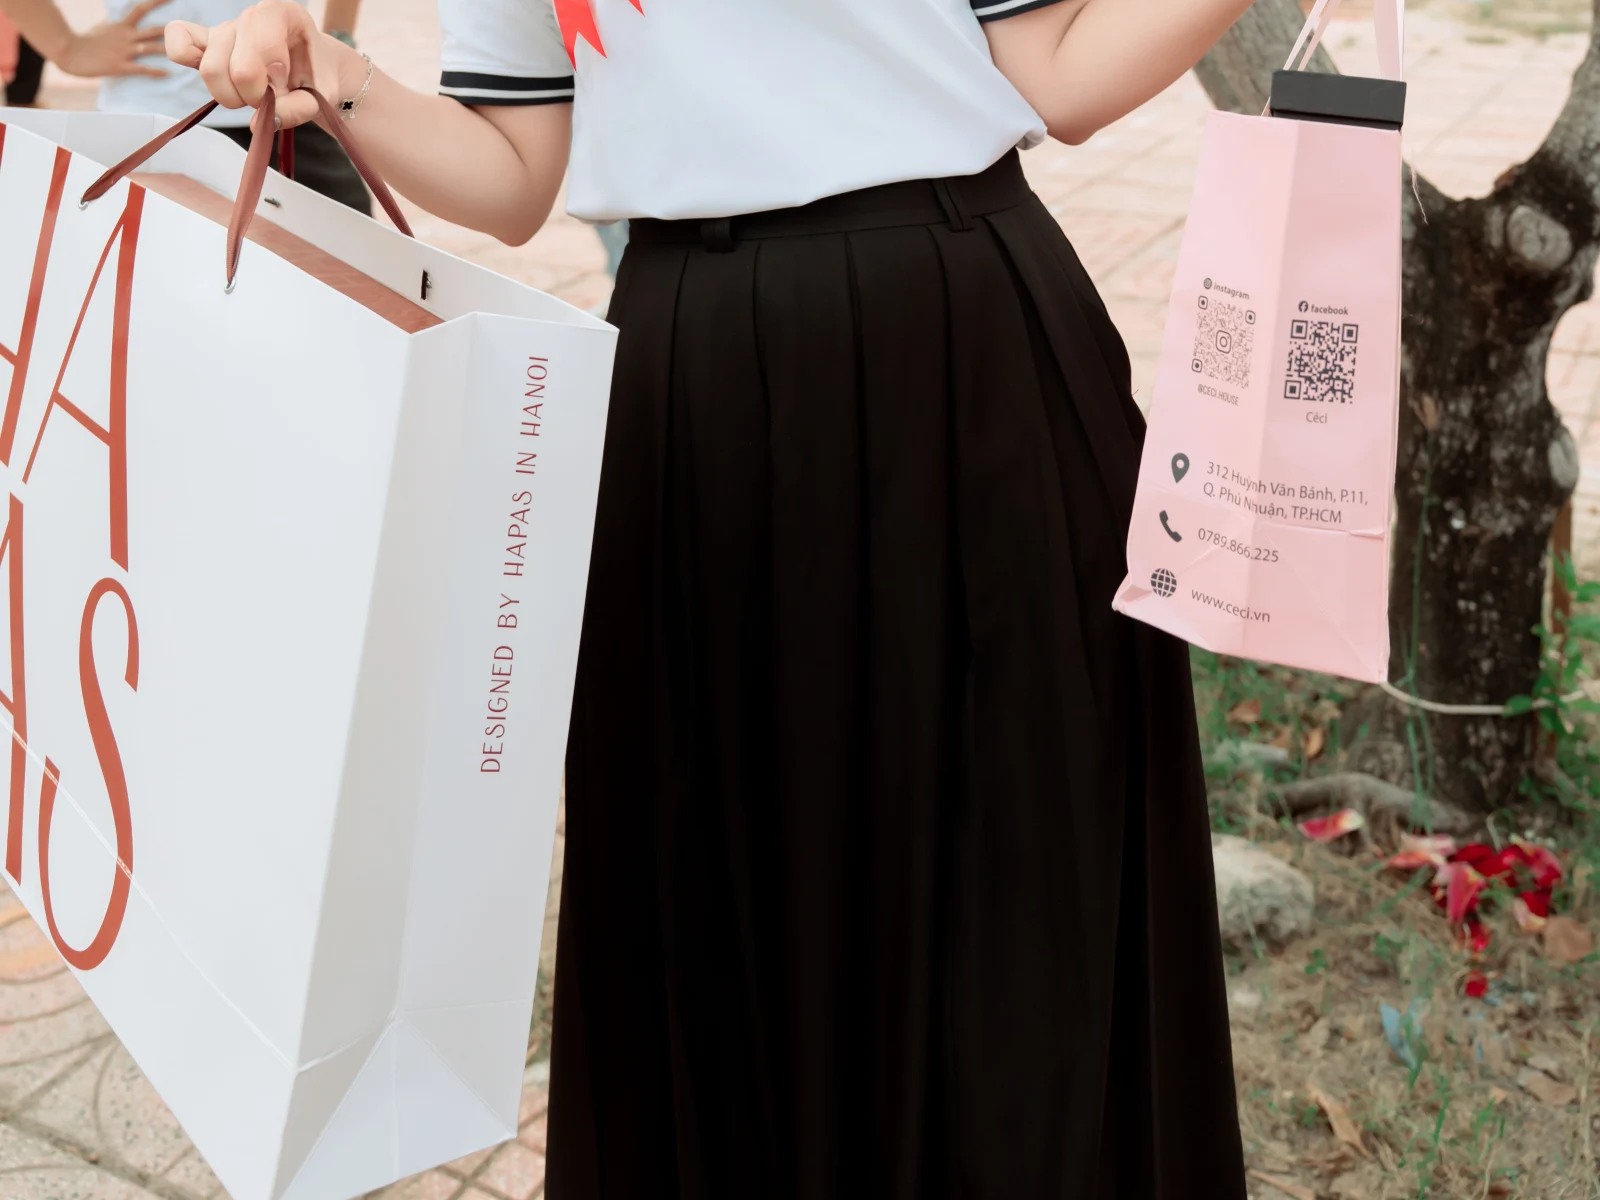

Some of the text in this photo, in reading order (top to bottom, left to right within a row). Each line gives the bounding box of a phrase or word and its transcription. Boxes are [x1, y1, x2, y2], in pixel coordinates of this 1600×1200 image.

[1213, 282, 1250, 300] instagram
[1310, 304, 1349, 316] facebook
[1305, 411, 1328, 424] Céci
[1207, 461, 1369, 506] 312 Huỳnh Văn Bánh, P.11,
[1203, 482, 1342, 524] Q. Phú Nhuận, TP.HCM
[1197, 527, 1280, 563] 0789.866.225
[480, 355, 550, 774] DESIGNED BY HAPAS IN HANOI
[1191, 588, 1271, 623] www.ceci.vn
